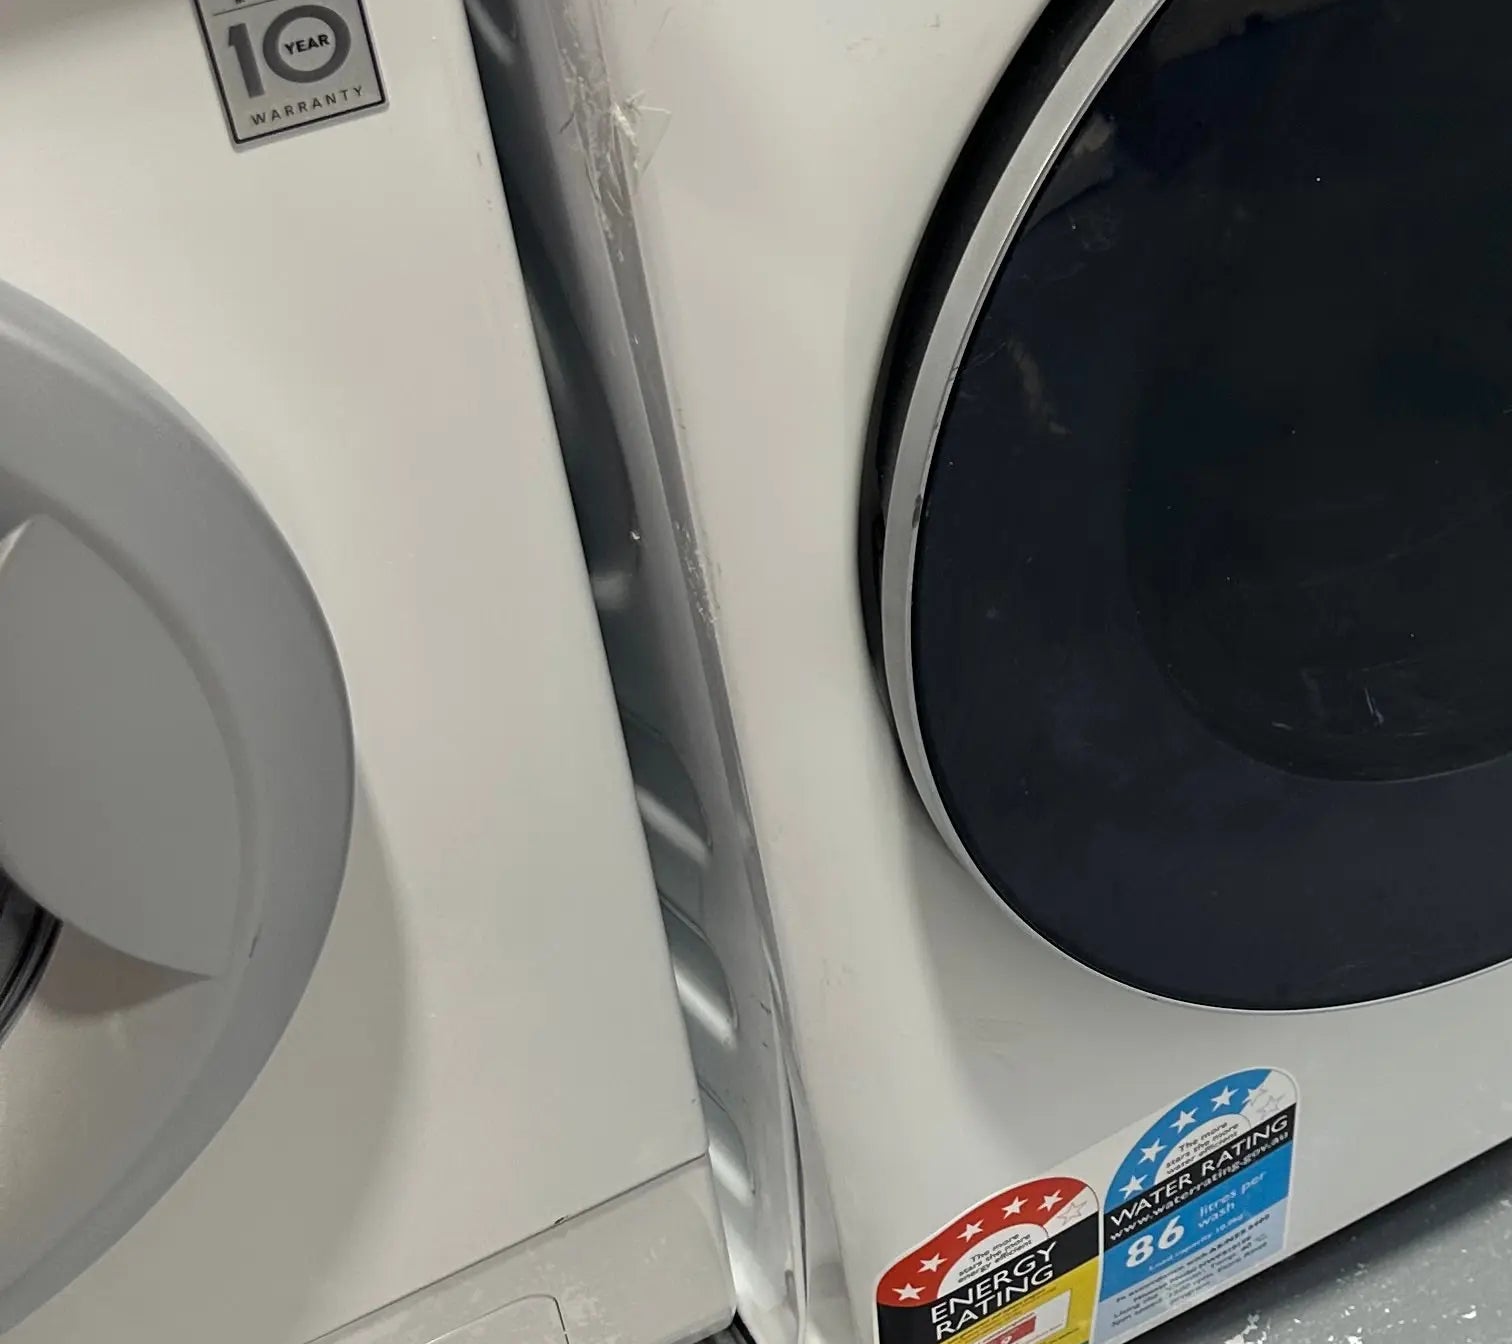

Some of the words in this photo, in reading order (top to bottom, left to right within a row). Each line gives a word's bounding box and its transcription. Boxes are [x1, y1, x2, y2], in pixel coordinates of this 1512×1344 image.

[228, 5, 351, 98] 10
[284, 34, 330, 56] YEAR
[251, 86, 364, 126] WARRANTY
[1166, 1152, 1190, 1168] stars
[1194, 1140, 1210, 1152] the
[1212, 1123, 1238, 1140] more
[1179, 1139, 1198, 1151] The
[1201, 1122, 1227, 1140] more
[1111, 1173, 1192, 1226] WATER
[1202, 1115, 1288, 1176] RATING
[1111, 1131, 1288, 1241] www.waterrating.gov.au
[1166, 1156, 1195, 1174] water
[1198, 1202, 1235, 1228] wash
[1200, 1189, 1237, 1216] litres
[1241, 1171, 1266, 1195] per
[959, 1261, 982, 1276] stars
[986, 1250, 1002, 1262] the
[1005, 1234, 1031, 1251] more
[970, 1250, 991, 1262] The
[993, 1234, 1019, 1251] more
[1126, 1215, 1184, 1268] 86
[931, 1241, 1057, 1324] ENERGY
[958, 1262, 991, 1283] energy
[936, 1264, 1053, 1341] RATING
